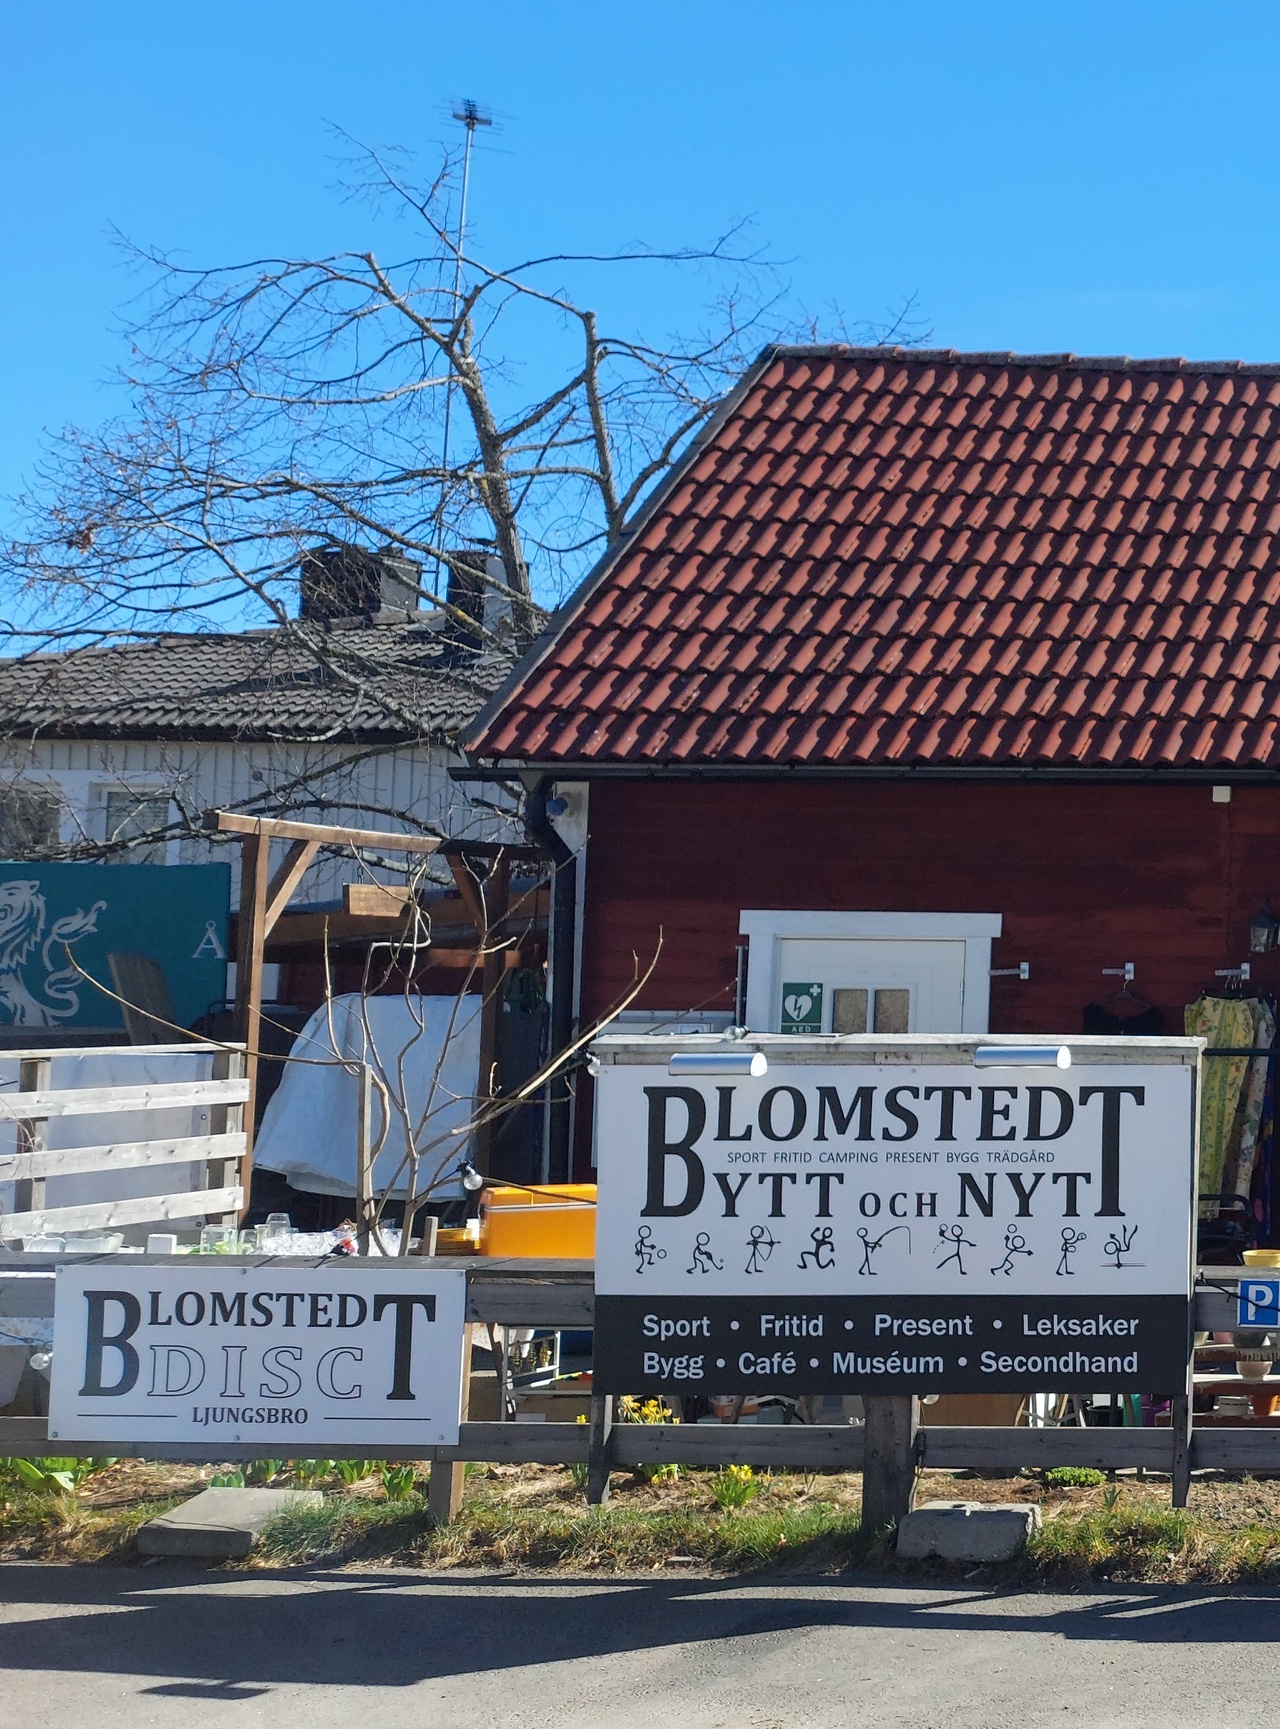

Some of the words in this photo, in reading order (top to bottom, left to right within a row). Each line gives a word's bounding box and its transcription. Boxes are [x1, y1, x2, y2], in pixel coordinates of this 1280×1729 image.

[640, 1085, 1146, 1218] BLOMSTEDT
[727, 1151, 767, 1164] SPORT
[773, 1151, 812, 1164] FRITID
[818, 1151, 879, 1164] CAMPING
[885, 1151, 940, 1164] PRESENT
[946, 1151, 980, 1164] BYGG
[986, 1149, 1055, 1164] TRÄDGÅRD
[858, 1191, 939, 1218] OCH
[642, 1313, 711, 1342] Sport
[760, 1314, 824, 1337] Fritid
[874, 1313, 974, 1337] Present
[1022, 1313, 1139, 1336] Leksaker
[77, 1290, 437, 1401] BLOMSTEDT
[146, 1344, 364, 1400] DISC
[643, 1352, 705, 1379] Bygg
[738, 1351, 797, 1374] Café
[833, 1350, 944, 1374] Muséum
[979, 1350, 1138, 1374] Secondhand
[192, 1406, 309, 1427] LJUNGSBRO
